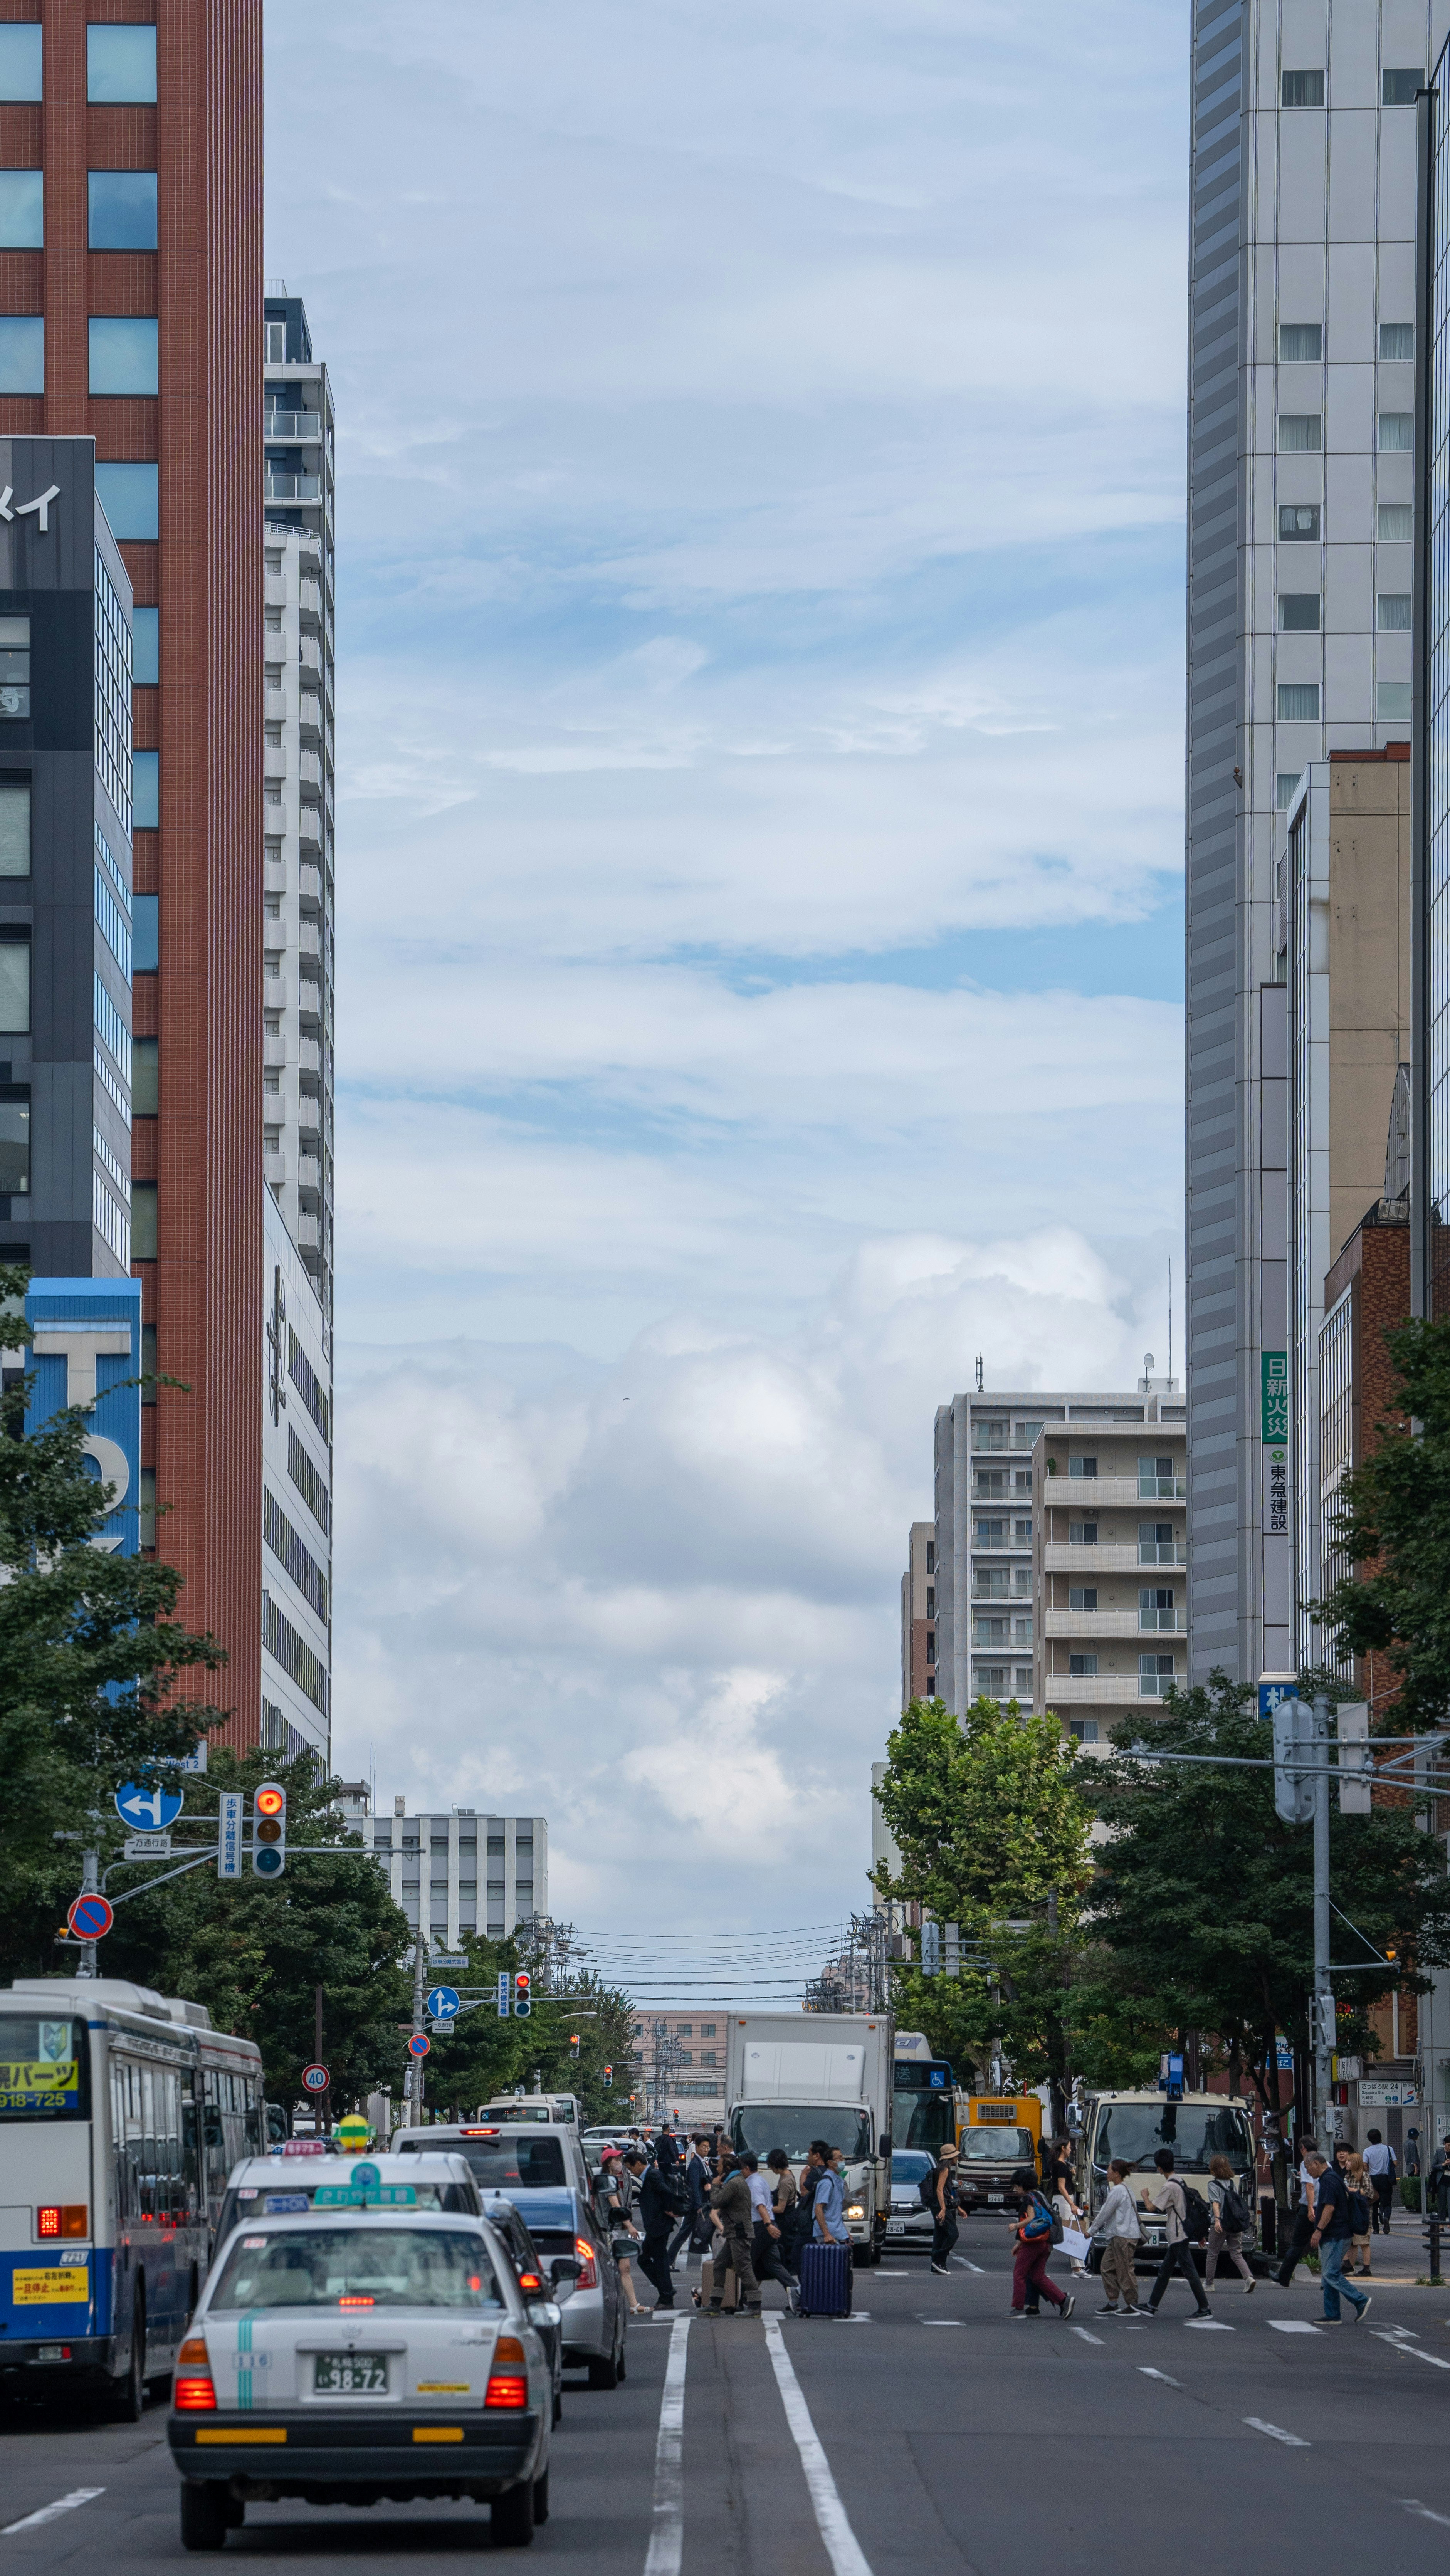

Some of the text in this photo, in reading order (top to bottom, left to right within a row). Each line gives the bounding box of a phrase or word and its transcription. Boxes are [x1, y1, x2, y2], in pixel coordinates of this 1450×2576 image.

[1267, 1358, 1288, 1436] 日新火災
[1270, 1464, 1287, 1530] 東急建設
[166, 1760, 198, 1768] West 2
[128, 1839, 167, 1847] 一方通行路
[225, 1798, 237, 1873] 歩車分離信号機
[309, 2072, 323, 2084] 40
[238, 2354, 268, 2368] 116
[329, 2369, 385, 2389] 98-72
